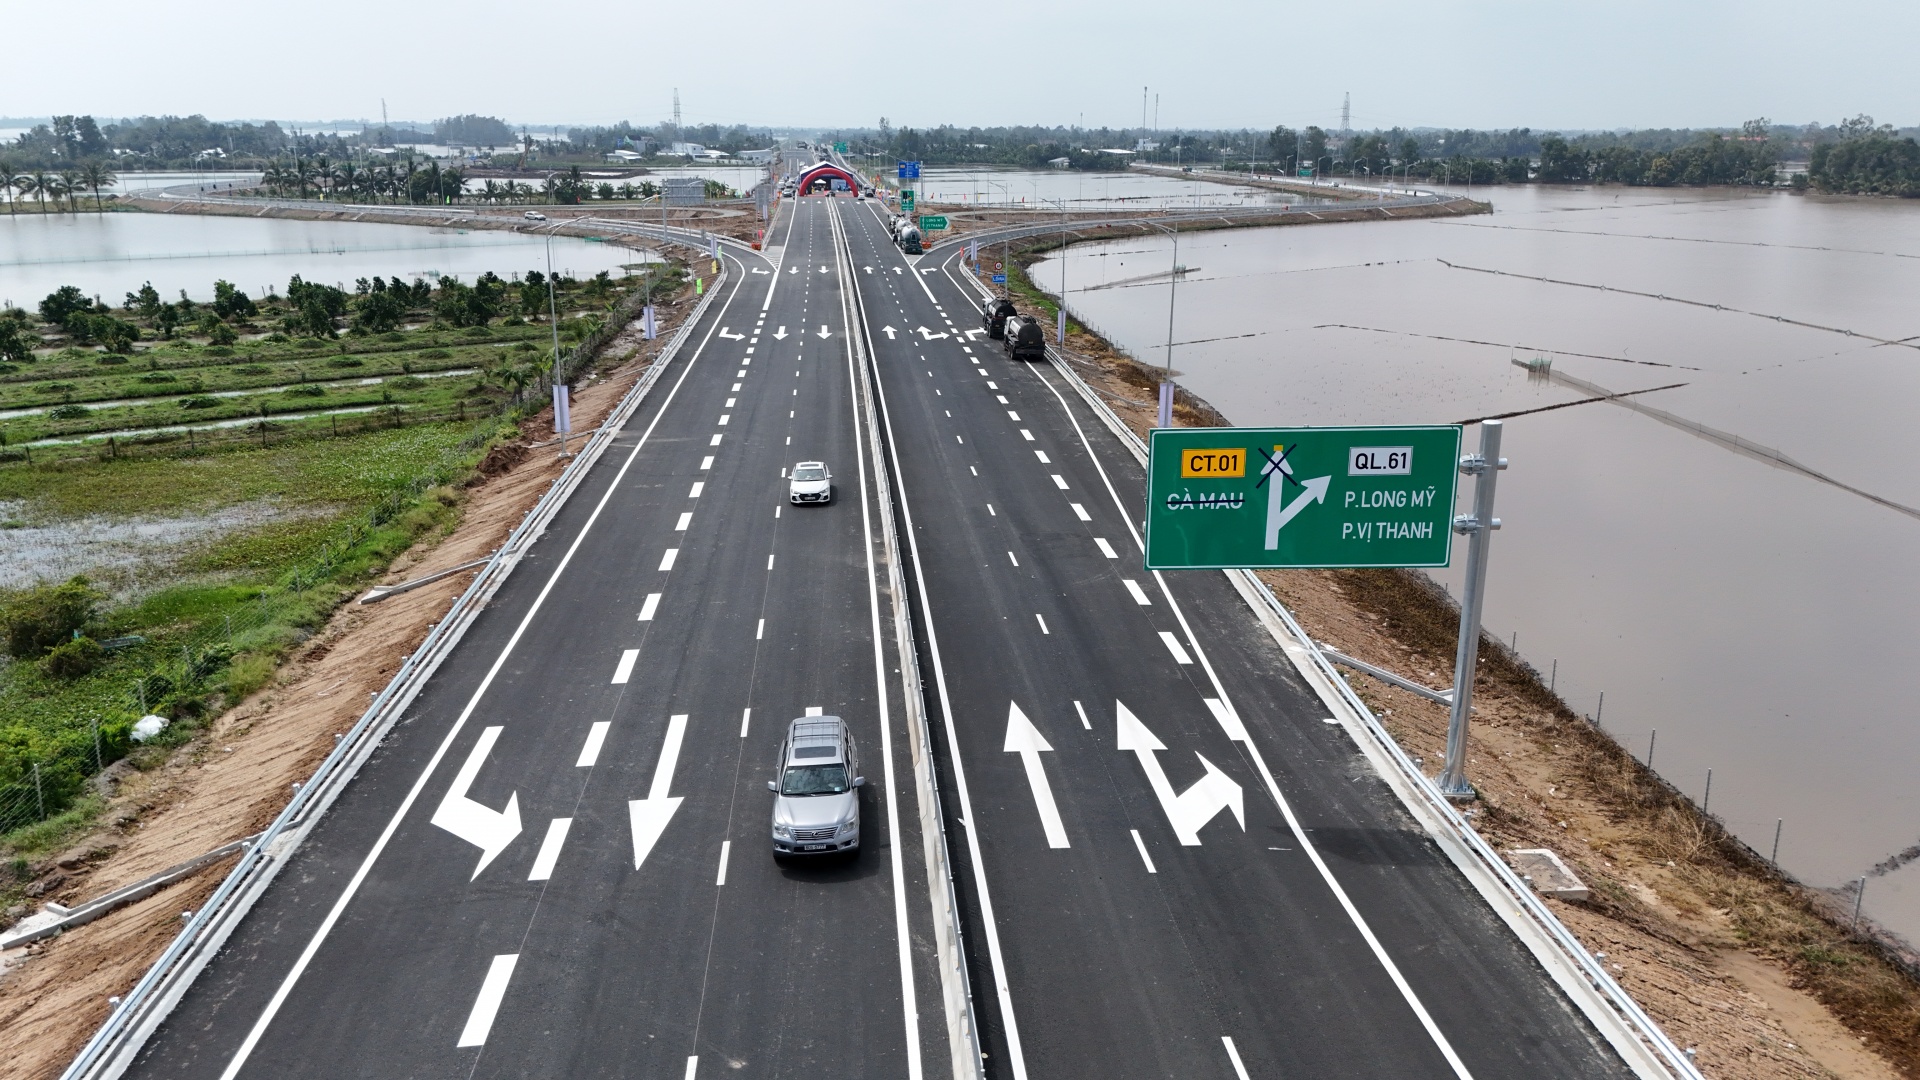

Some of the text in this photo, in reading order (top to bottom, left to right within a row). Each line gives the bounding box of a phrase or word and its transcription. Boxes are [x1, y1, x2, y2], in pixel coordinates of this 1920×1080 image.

[1190, 454, 1238, 472] CT.01
[1355, 452, 1407, 470] QL.61
[1167, 487, 1244, 510] CÀ MAU
[1345, 485, 1436, 508] P.LONG MỸ
[1342, 522, 1433, 542] P.VỊ THANH
